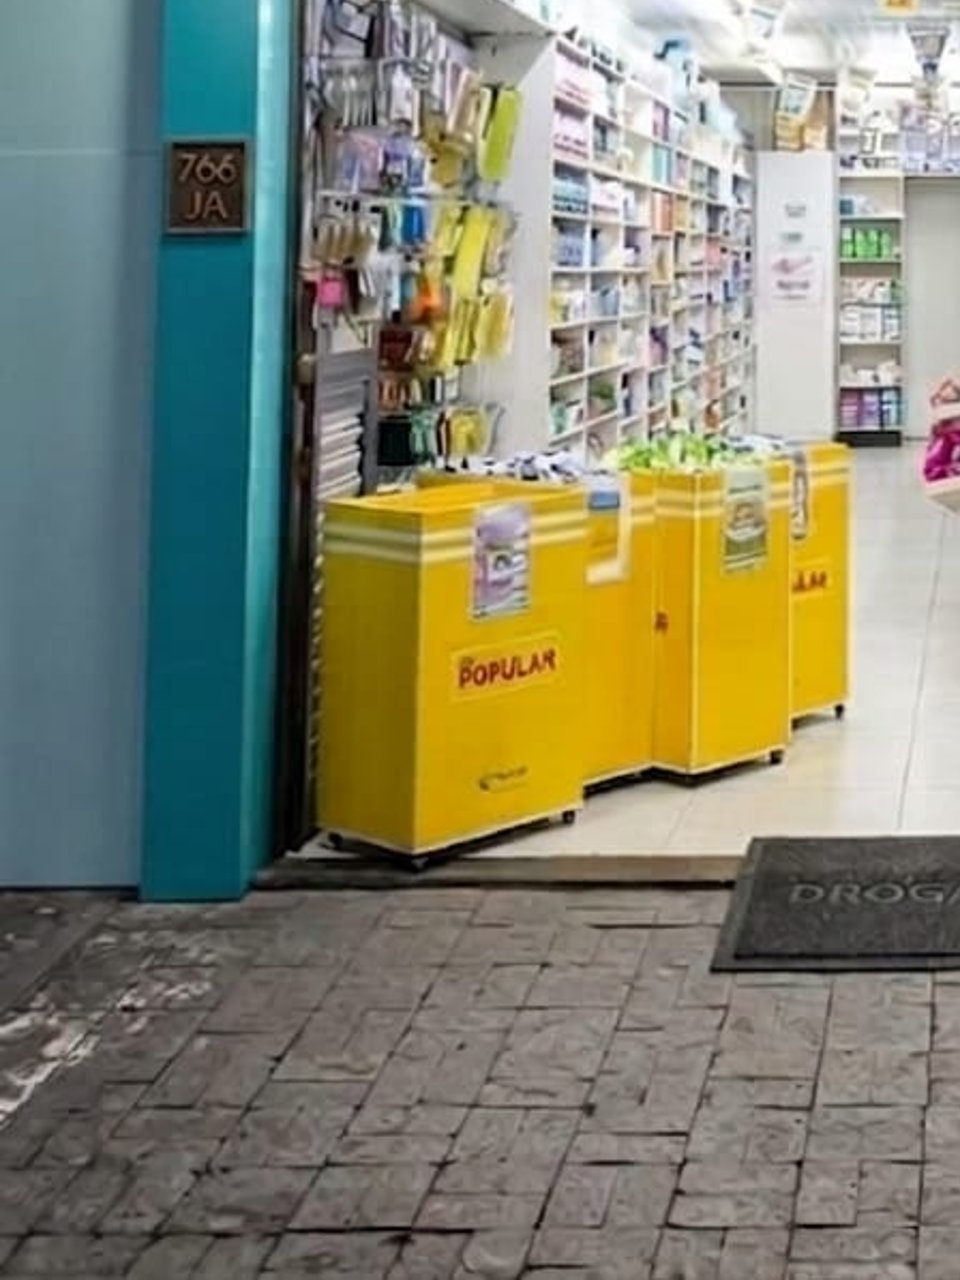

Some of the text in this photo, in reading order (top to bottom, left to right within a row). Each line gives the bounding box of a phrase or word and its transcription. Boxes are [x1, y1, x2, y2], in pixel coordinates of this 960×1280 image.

[177, 152, 237, 184] 766
[185, 190, 229, 220] JA
[458, 646, 557, 690] POPULAR
